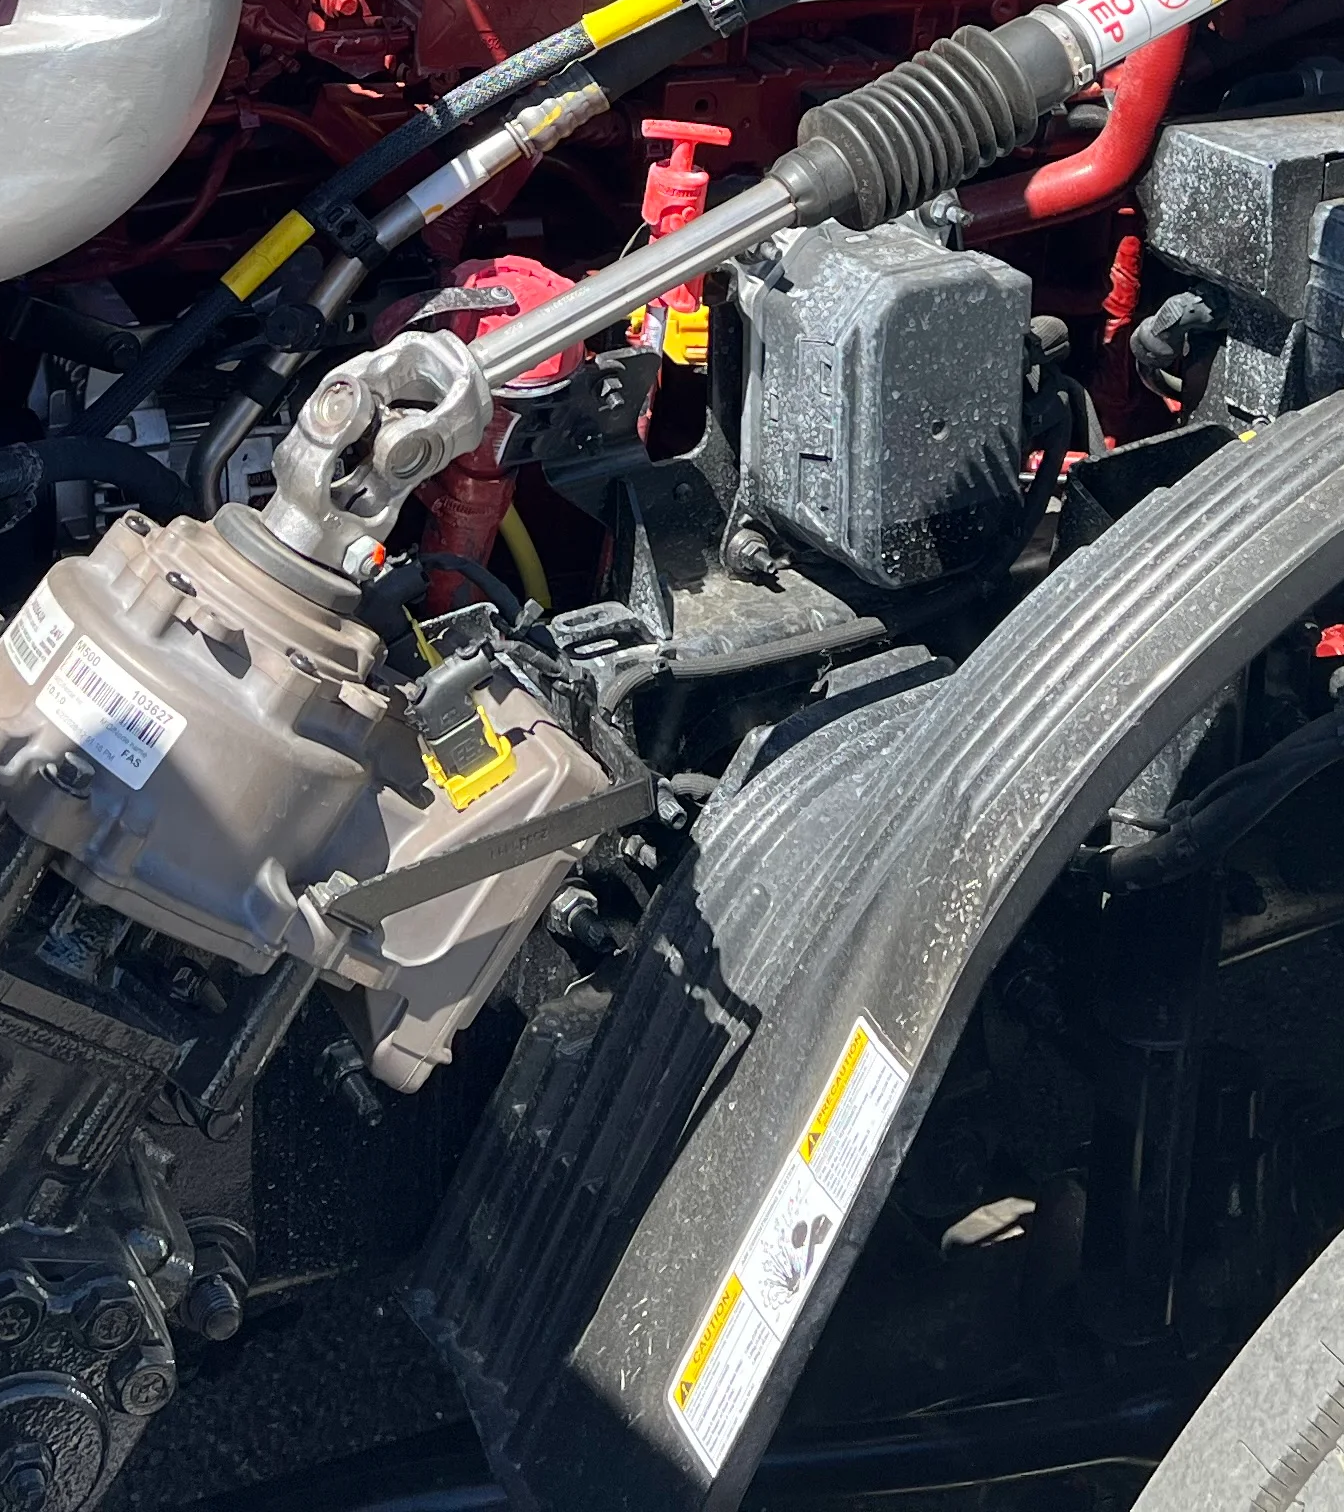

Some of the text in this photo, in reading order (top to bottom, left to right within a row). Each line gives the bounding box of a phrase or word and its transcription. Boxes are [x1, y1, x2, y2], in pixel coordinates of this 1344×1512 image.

[76, 640, 101, 667] M500
[131, 690, 174, 725] 103627
[120, 749, 142, 768] FAS
[816, 1031, 864, 1126] PRECAUTION
[692, 1289, 731, 1365] CAUTION
